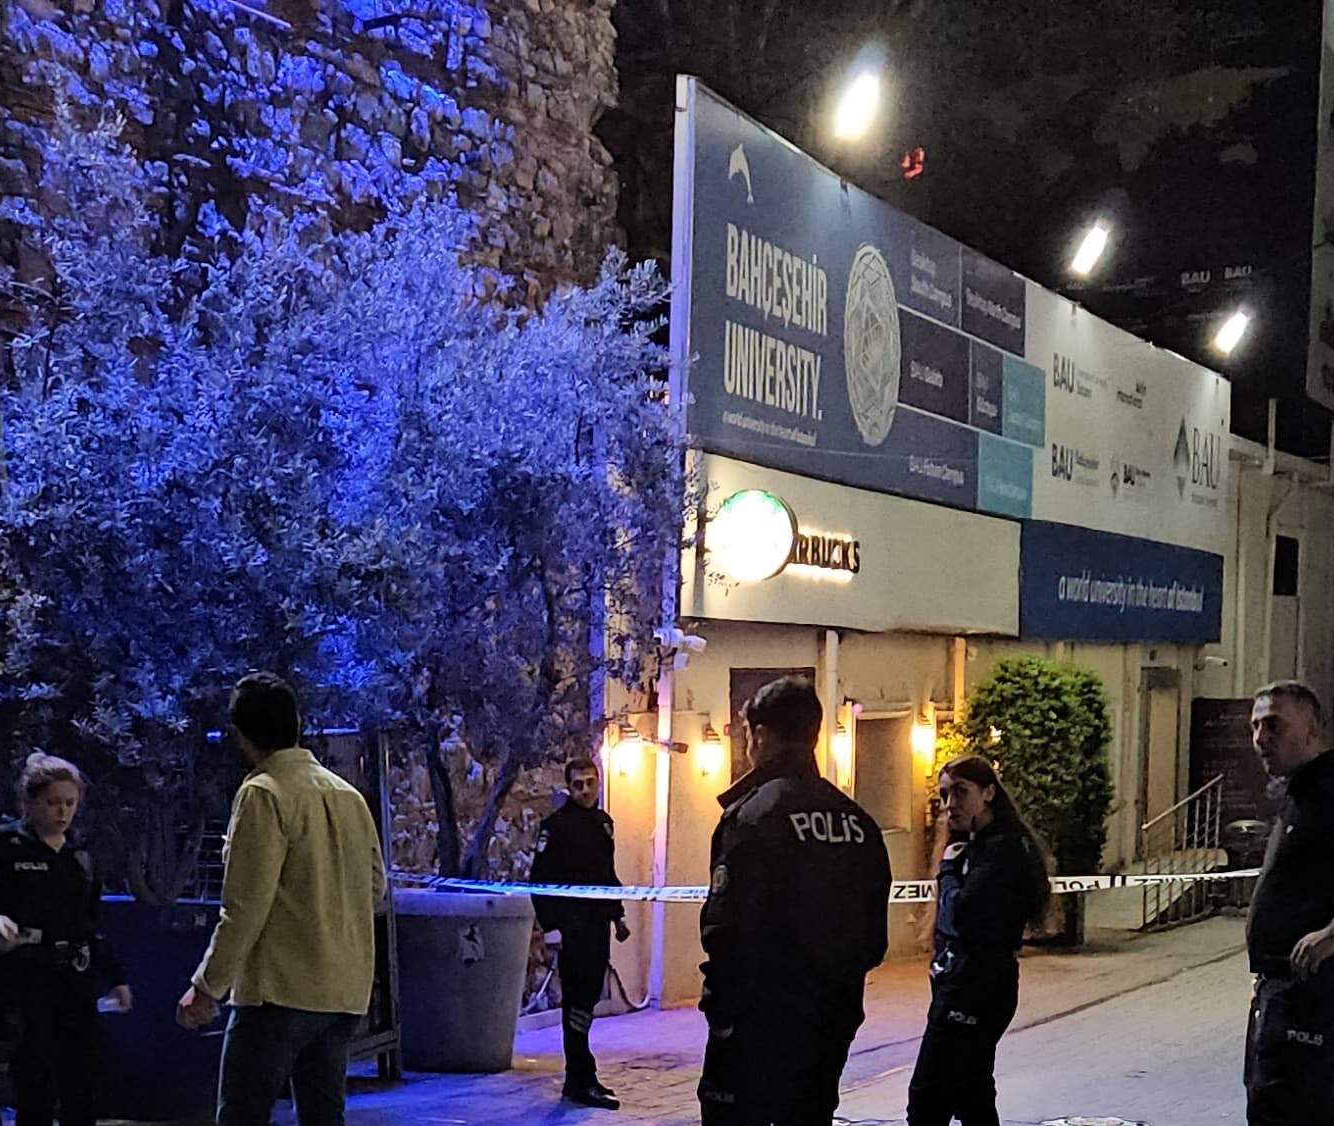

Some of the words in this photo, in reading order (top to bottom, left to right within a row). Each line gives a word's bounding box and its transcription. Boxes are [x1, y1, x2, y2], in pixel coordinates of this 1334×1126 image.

[726, 222, 827, 336] BAHÇEŞEHİR
[1181, 270, 1211, 286] BAU
[1053, 353, 1075, 393] BAU
[1052, 443, 1073, 482] BAU
[1192, 427, 1220, 489] BAU
